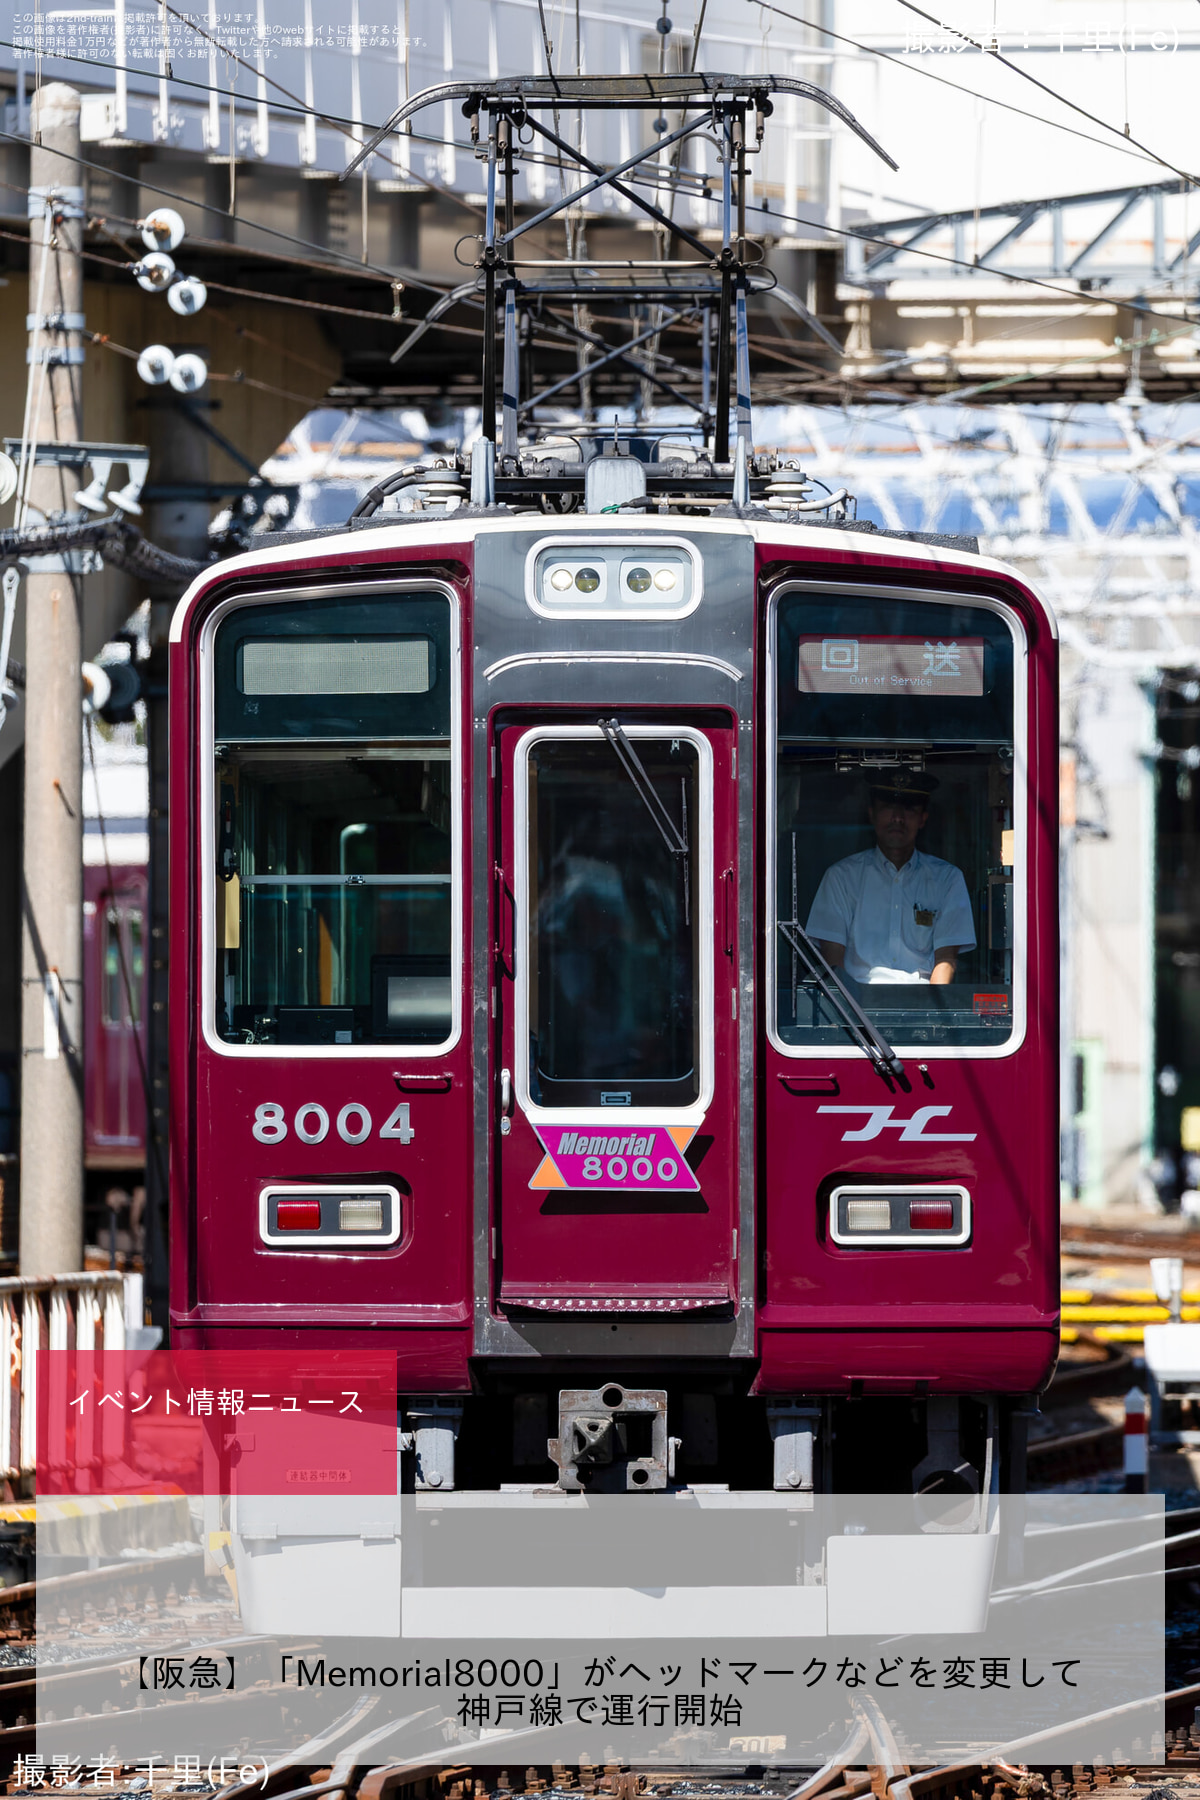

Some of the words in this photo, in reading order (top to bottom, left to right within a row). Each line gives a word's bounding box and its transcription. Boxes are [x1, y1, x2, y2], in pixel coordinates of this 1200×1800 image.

[850, 674, 869, 686] Out
[873, 675, 886, 686] of
[890, 675, 933, 687] Service
[252, 1102, 415, 1145] 8004
[556, 1132, 657, 1156] Memorial
[582, 1156, 679, 1182] 8000
